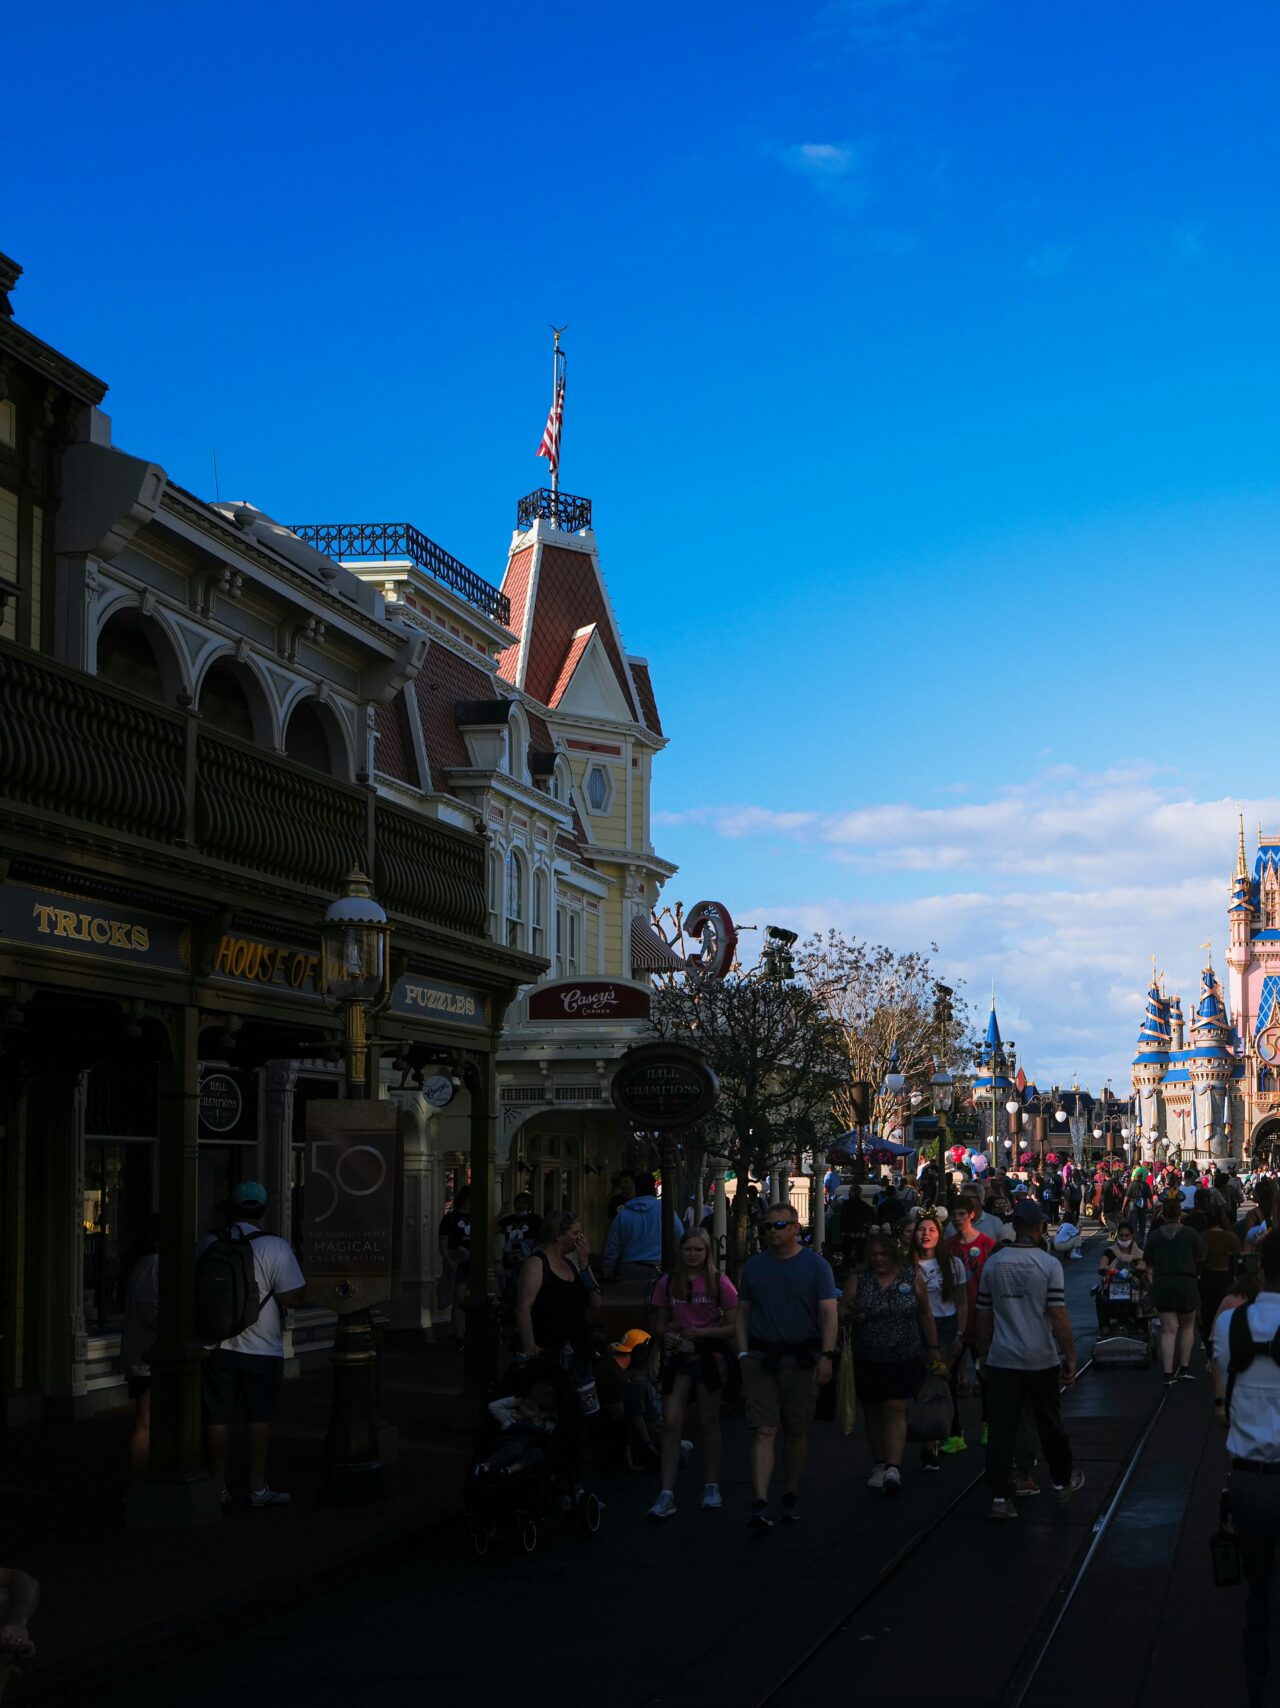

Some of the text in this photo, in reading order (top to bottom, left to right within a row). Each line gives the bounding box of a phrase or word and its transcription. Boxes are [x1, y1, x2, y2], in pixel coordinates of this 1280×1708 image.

[32, 903, 150, 951] TRICKS
[213, 935, 288, 984] HOUSE
[288, 951, 319, 988] OF
[405, 984, 475, 1016] PUZZLES
[560, 986, 619, 1012] Casey's
[625, 1085, 701, 1096] CHAMPIONS
[312, 1141, 387, 1223] 50
[314, 1241, 384, 1252] MAGICAL
